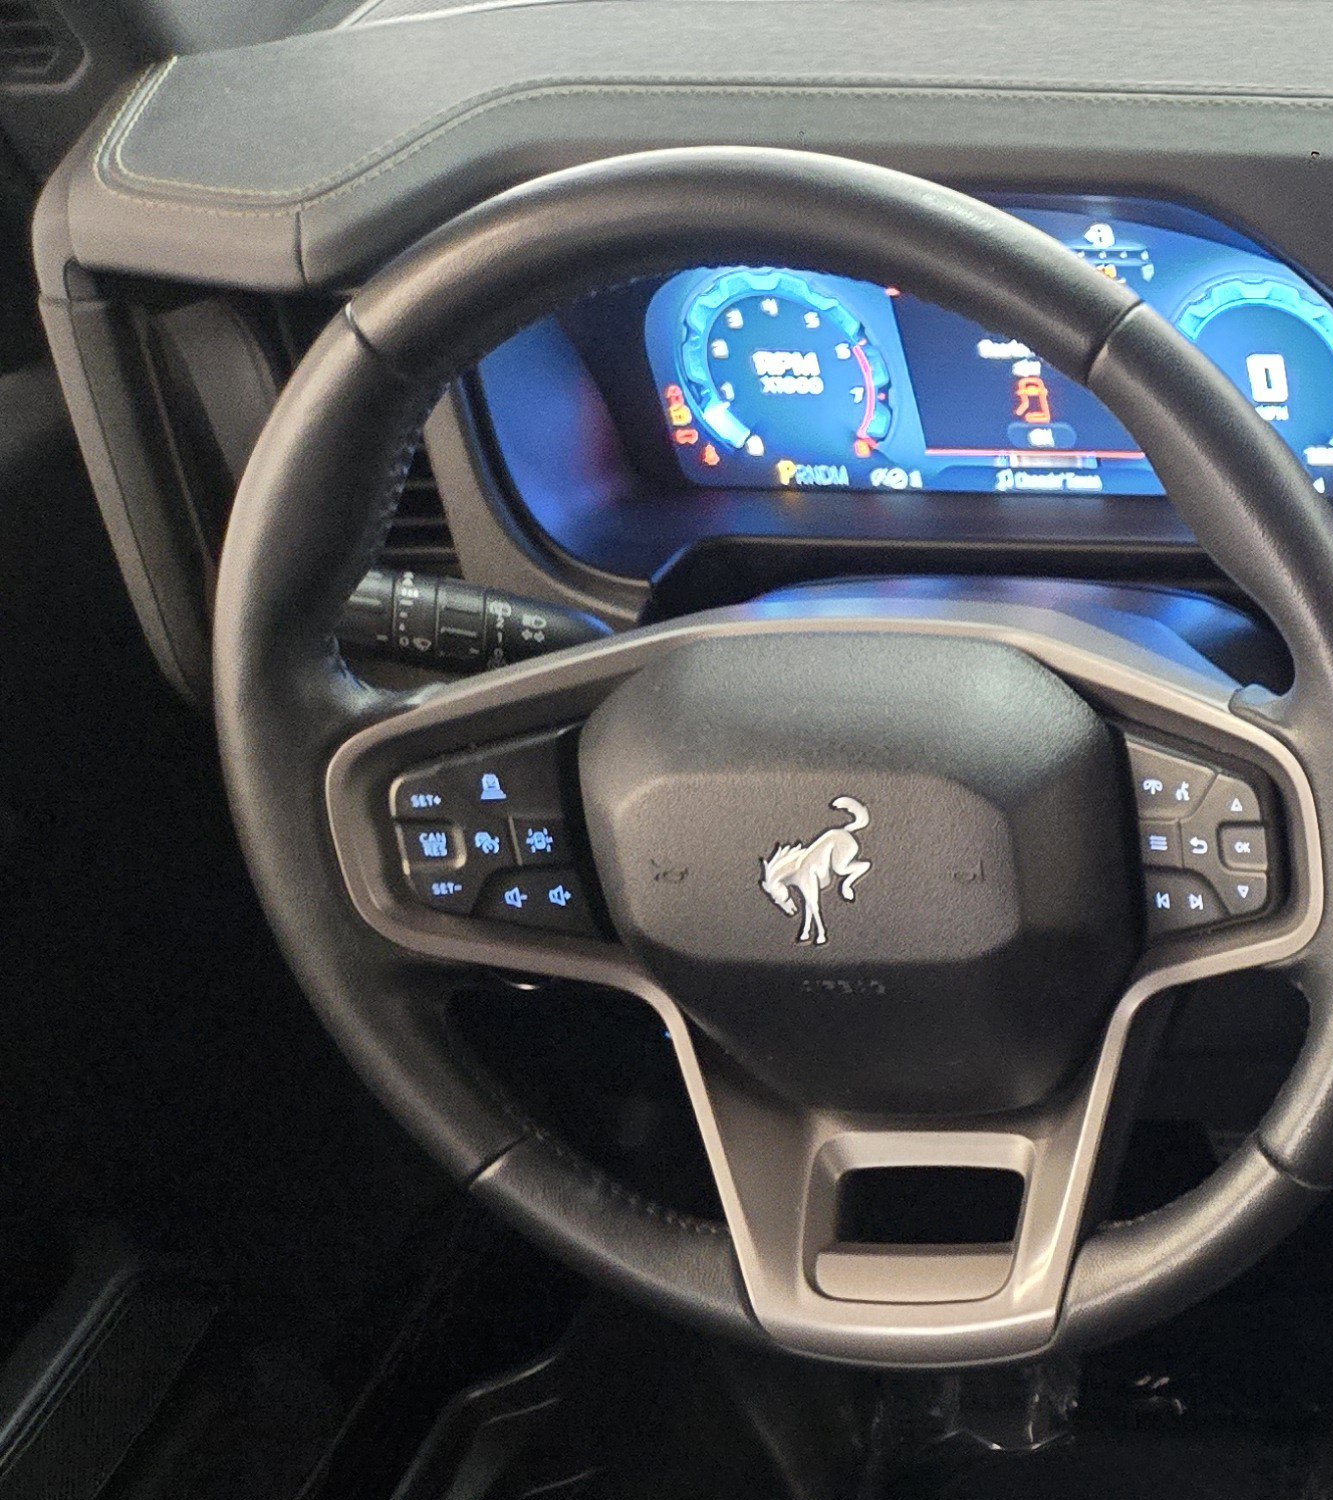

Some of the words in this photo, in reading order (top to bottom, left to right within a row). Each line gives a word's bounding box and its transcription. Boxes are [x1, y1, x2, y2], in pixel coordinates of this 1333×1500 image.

[762, 299, 779, 317] 4
[727, 307, 744, 329] 3
[803, 310, 821, 329] 5
[752, 350, 822, 376] RPM
[1246, 353, 1289, 403] 0
[850, 386, 865, 404] 7
[1234, 841, 1251, 854] OK
